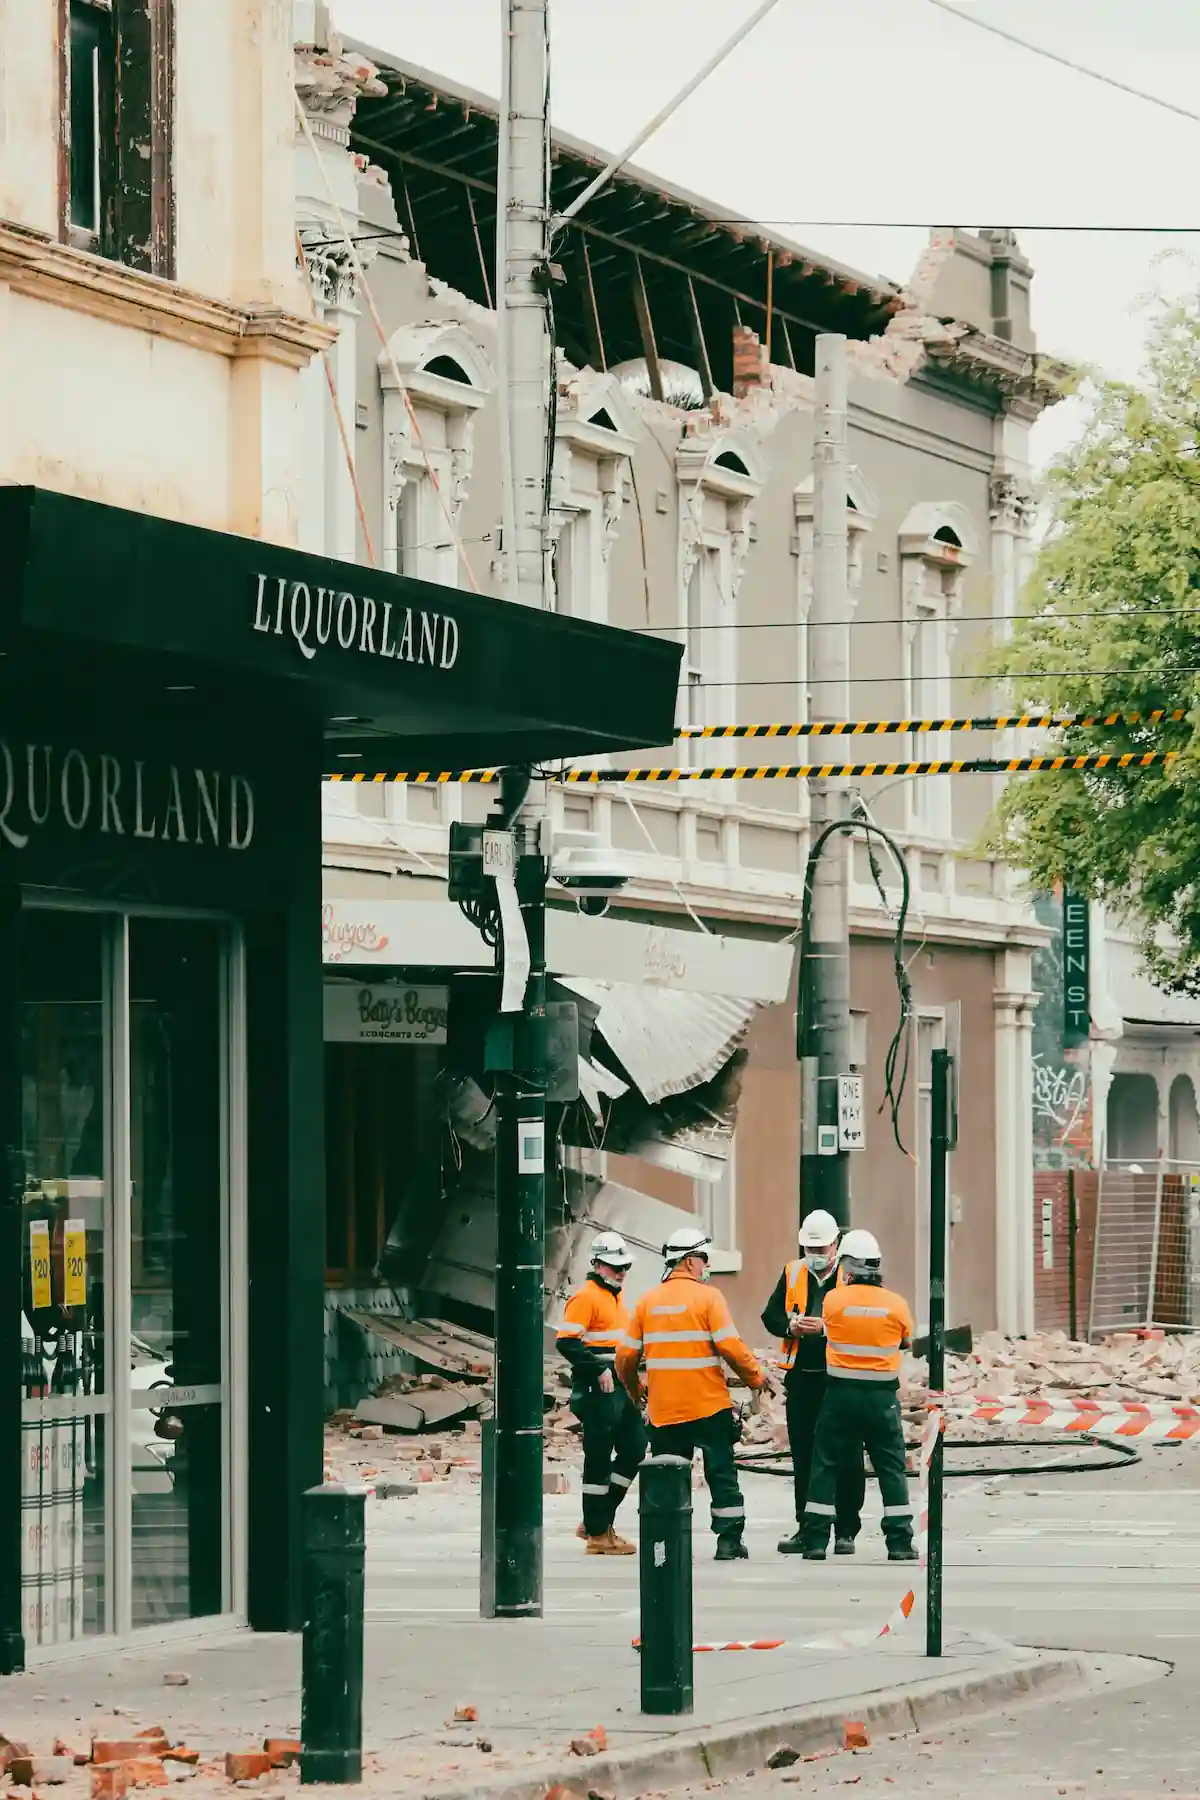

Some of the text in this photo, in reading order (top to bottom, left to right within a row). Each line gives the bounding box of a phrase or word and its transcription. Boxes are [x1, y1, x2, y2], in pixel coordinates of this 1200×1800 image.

[253, 573, 459, 669] LIQUORLAND
[843, 1082, 860, 1098] ONE
[842, 1107, 860, 1121] WAY
[67, 1257, 83, 1276] $20
